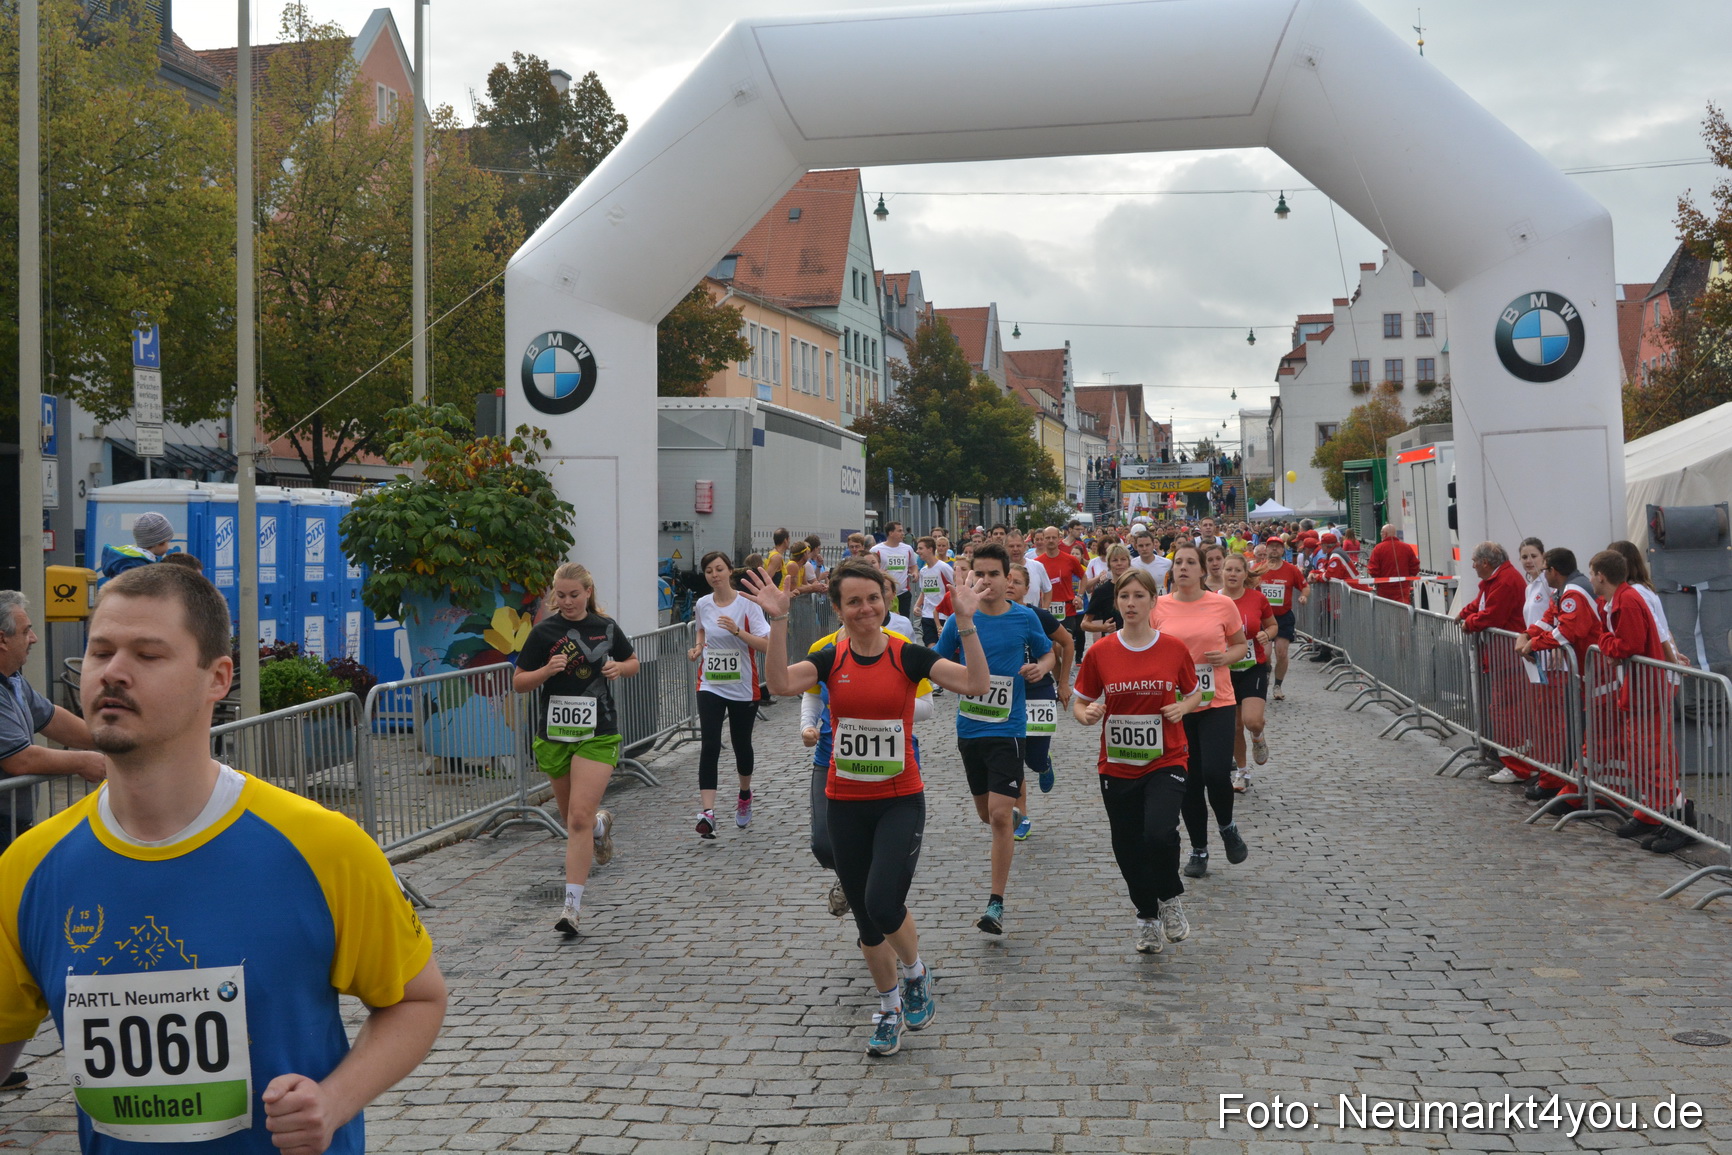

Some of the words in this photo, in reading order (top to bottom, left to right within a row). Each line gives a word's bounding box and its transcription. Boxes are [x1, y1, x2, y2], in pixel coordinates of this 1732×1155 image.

[1501, 293, 1578, 326] BMW
[525, 332, 591, 361] BMW
[79, 480, 86, 498] 3
[1150, 481, 1181, 490] START
[216, 521, 234, 547] DIXI
[260, 521, 276, 545] DIXI
[306, 521, 325, 545] DIXI
[888, 558, 905, 566] 5191
[923, 579, 938, 588] 5224
[1262, 589, 1282, 598] 5551
[707, 657, 738, 671] 5219
[1105, 680, 1164, 694] NEUMARKT
[552, 707, 592, 725] 5062
[967, 704, 1000, 717] Johannes
[558, 727, 583, 736] Theresa
[858, 725, 892, 733] Neumarkt
[1110, 726, 1157, 747] 5050
[840, 733, 895, 758] 5011
[1119, 749, 1149, 759] Melanie
[851, 762, 884, 773] Marion
[79, 910, 90, 920] 15
[71, 923, 95, 934] Jahre
[67, 991, 121, 1009] PARTL
[125, 986, 211, 1007] Neumarkt
[83, 1010, 231, 1080] 5060
[74, 1075, 82, 1086] S
[112, 1092, 204, 1119] Michael
